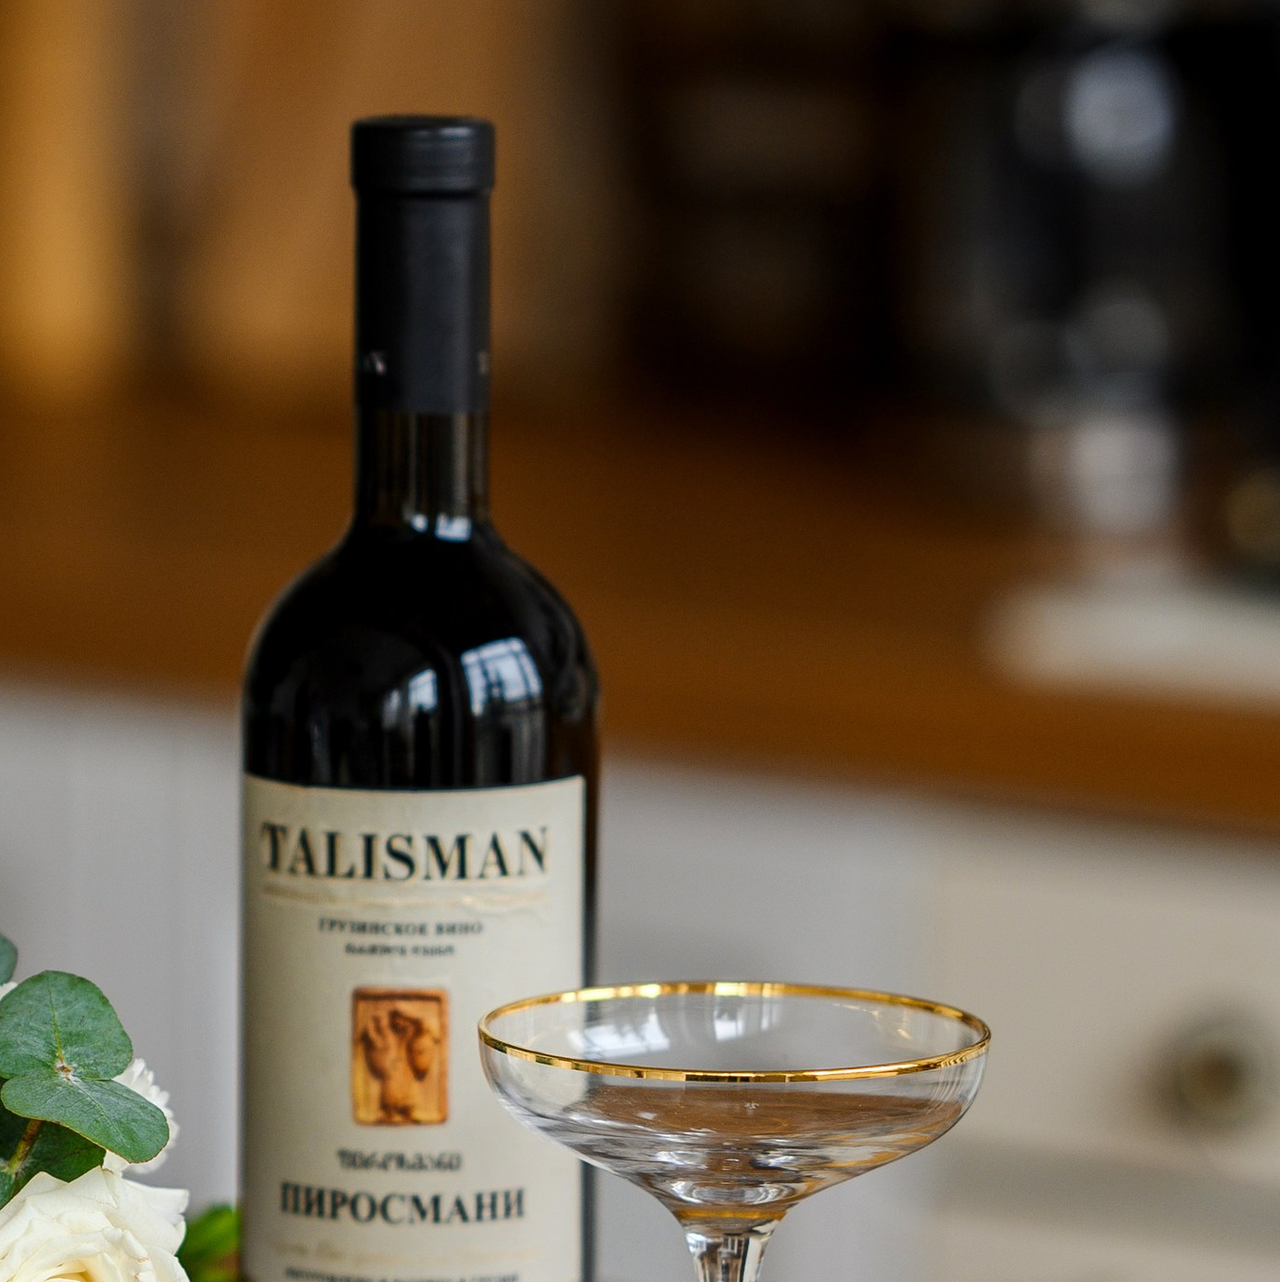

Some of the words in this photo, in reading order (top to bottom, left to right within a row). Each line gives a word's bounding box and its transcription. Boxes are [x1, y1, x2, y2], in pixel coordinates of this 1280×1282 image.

[261, 821, 548, 881] TALISMAN
[319, 917, 428, 936] ГРУЗИНСКОЕ
[436, 921, 484, 935] ВИНО
[279, 1181, 526, 1224] ПИРОСМАНИ
